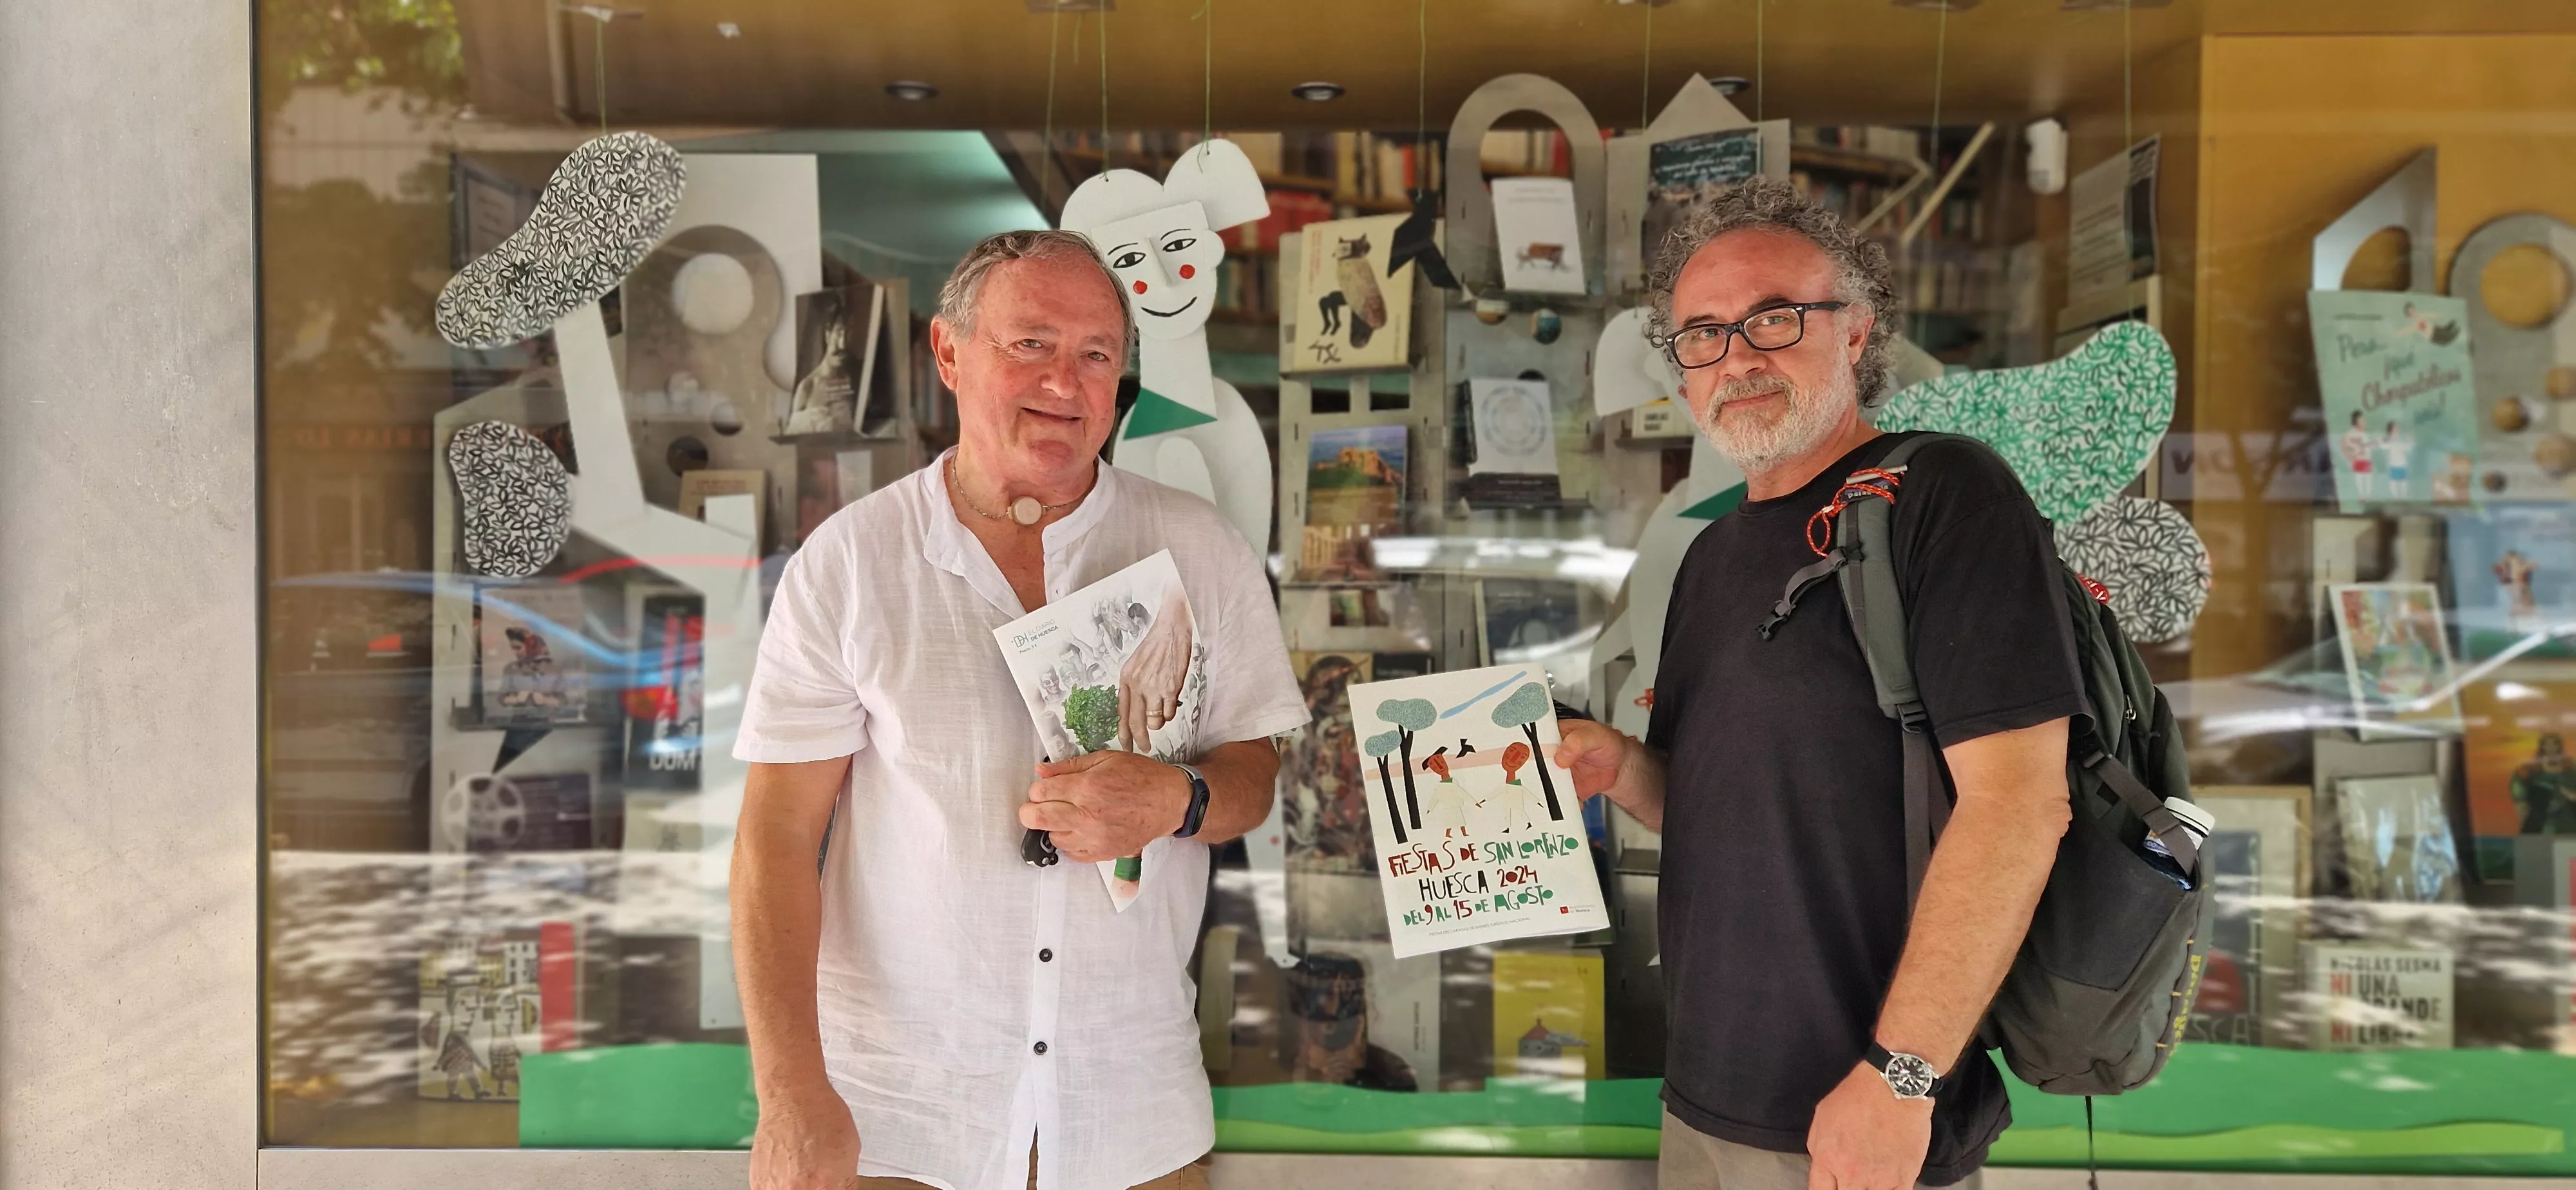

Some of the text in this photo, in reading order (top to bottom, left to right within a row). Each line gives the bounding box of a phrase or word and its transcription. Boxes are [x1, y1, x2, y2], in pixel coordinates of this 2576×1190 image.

[1848, 484, 1889, 499] pataia
[1038, 625, 1059, 638] HUESCA
[1388, 831, 1579, 877] FIESTAS DE SAN LORENZO
[1418, 864, 1539, 902] HUESCA 2024
[1403, 884, 1553, 927] DEL 9 AL 15 DE AGOSTO
[2357, 974, 2401, 997] UNA
